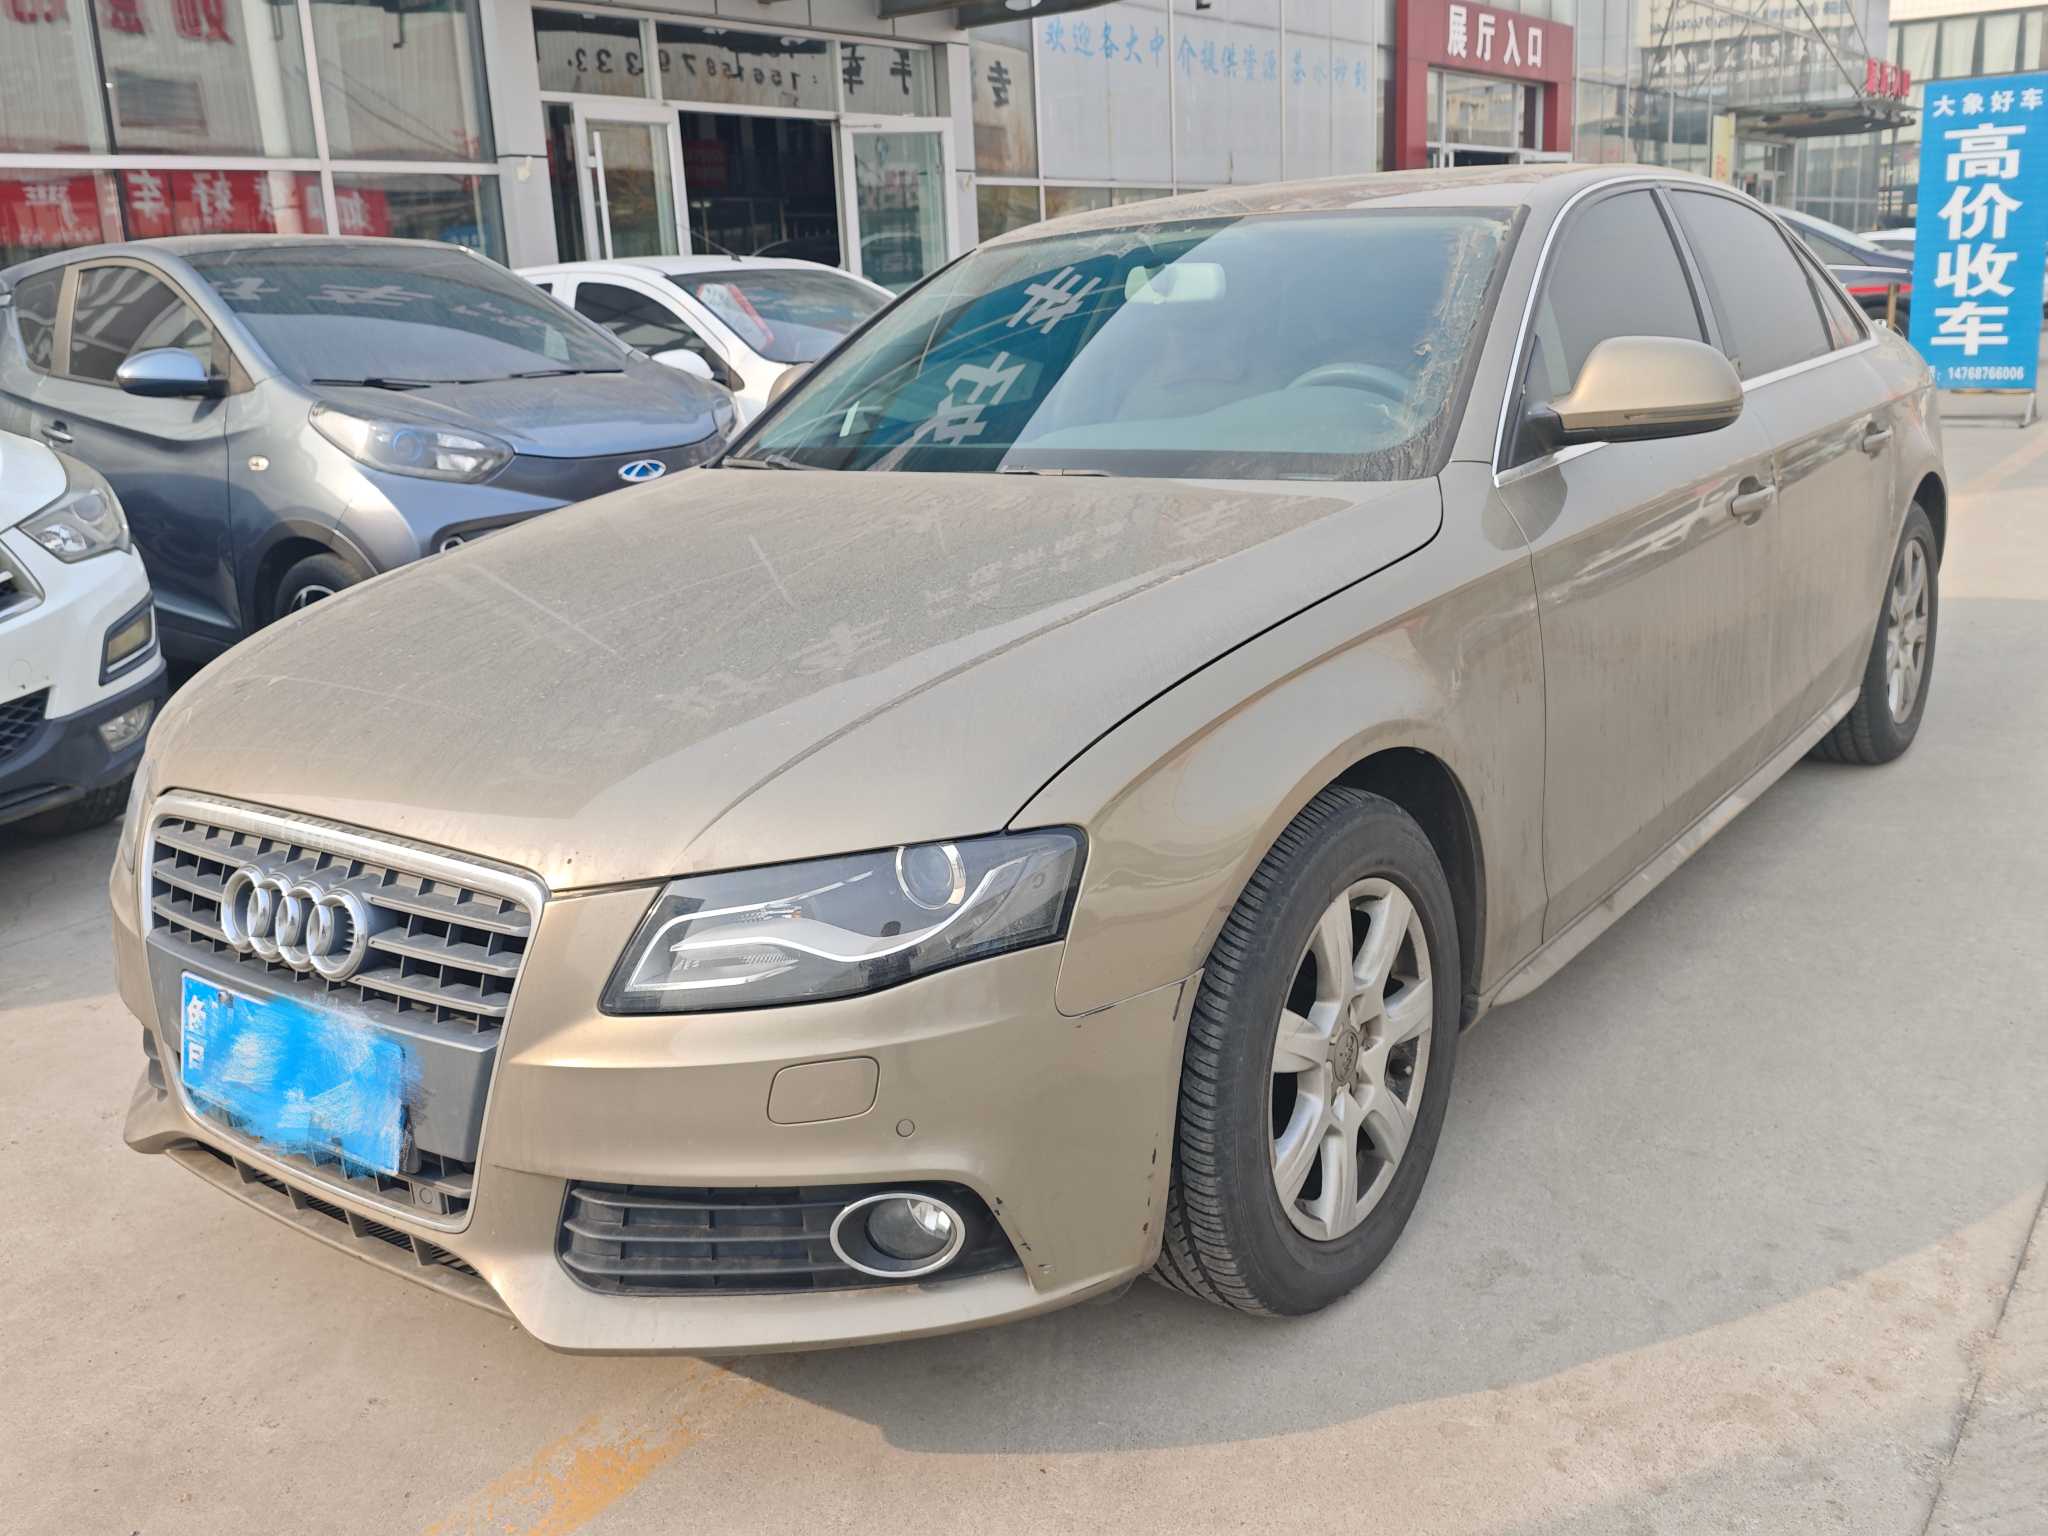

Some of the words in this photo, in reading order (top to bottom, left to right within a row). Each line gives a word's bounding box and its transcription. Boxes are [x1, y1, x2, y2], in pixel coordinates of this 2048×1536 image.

[1447, 4, 1543, 69] 展厅入口
[1932, 87, 2044, 118] 大象好车
[1930, 122, 2027, 356] 高价收车
